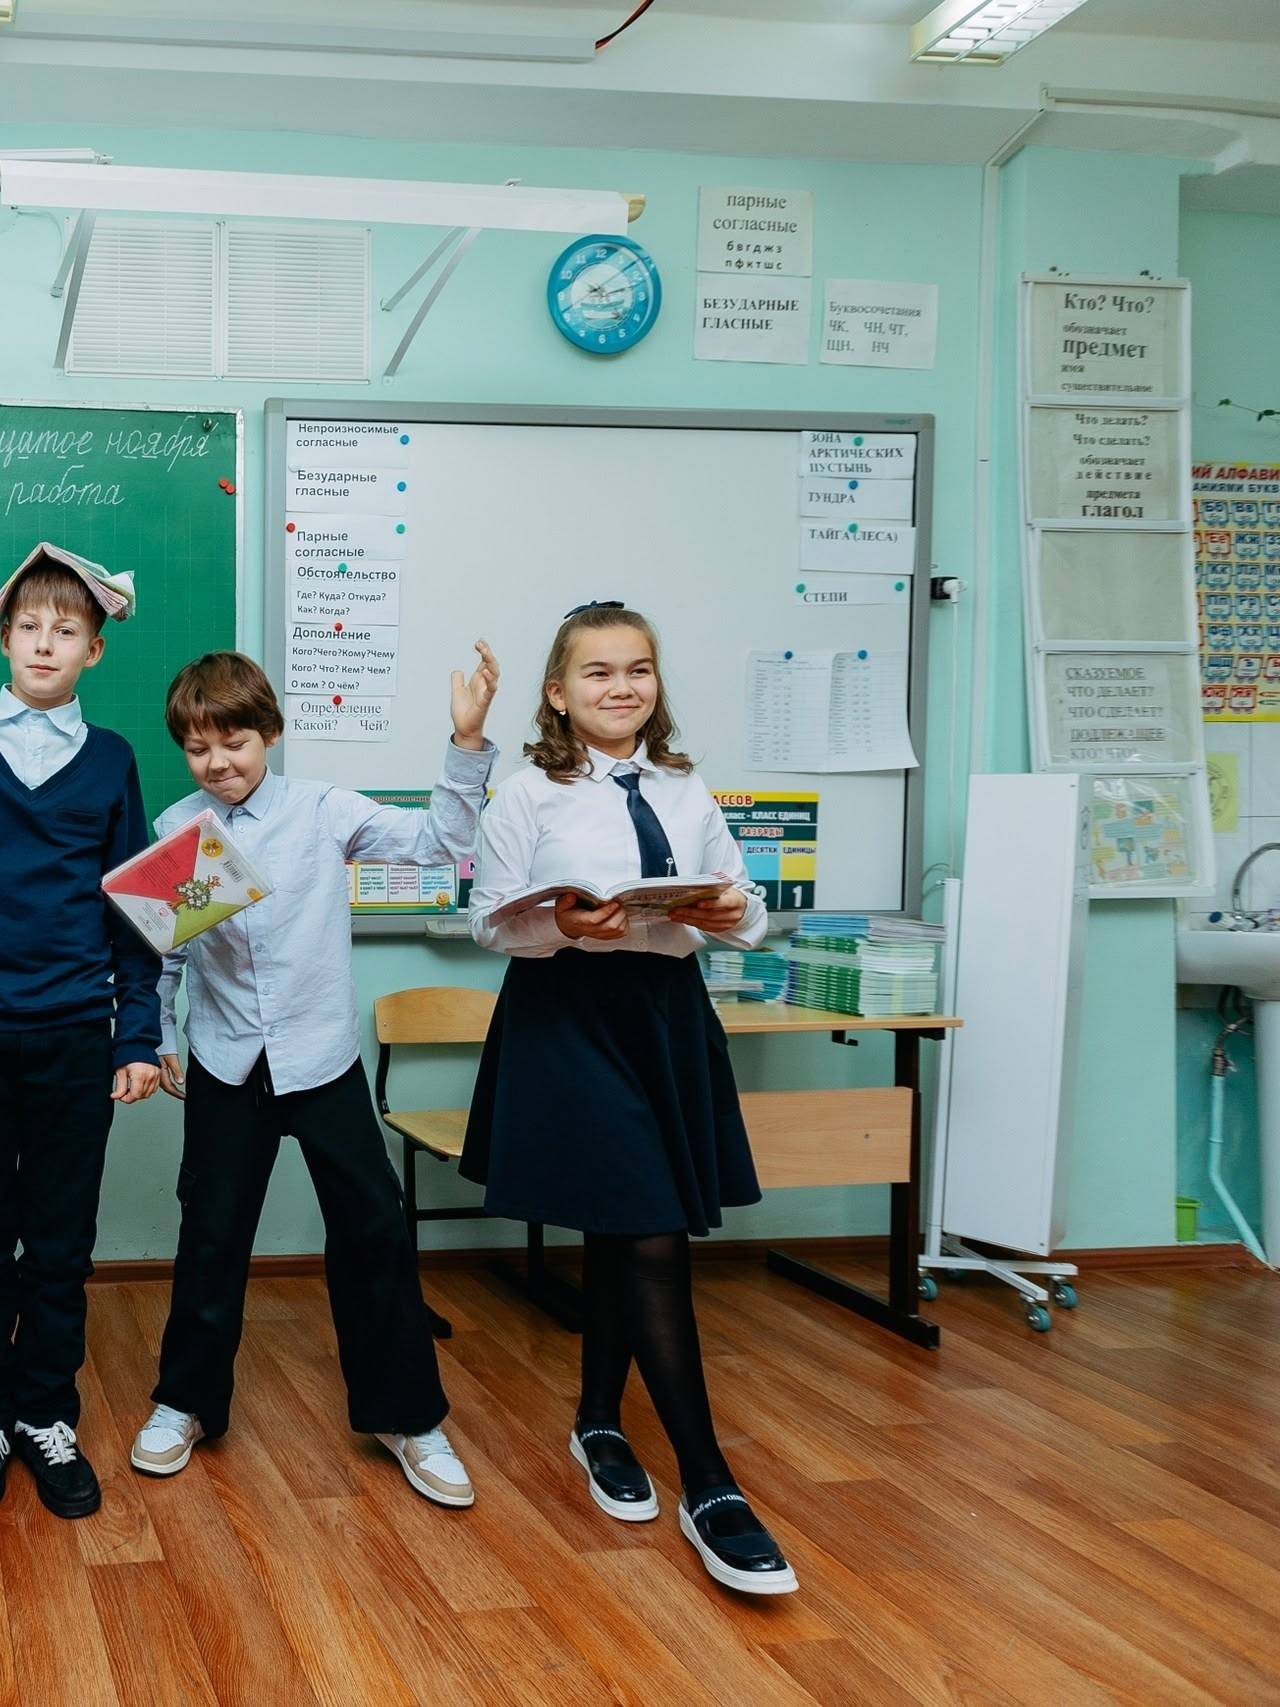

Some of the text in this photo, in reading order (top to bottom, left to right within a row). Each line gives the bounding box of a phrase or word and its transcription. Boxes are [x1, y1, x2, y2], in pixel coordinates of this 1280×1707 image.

[726, 194, 787, 211] парные
[713, 217, 798, 233] согласные
[596, 249, 607, 258] 12
[703, 298, 799, 312] БЕЗУДАРНЫЕ
[829, 301, 922, 317] Буквосочетания
[1064, 293, 1155, 313] Кто? Что?
[702, 317, 774, 331] ГЛАСНЫЕ
[1063, 340, 1149, 359] предмет
[1075, 414, 1098, 424] Что
[298, 423, 399, 435] Непроизносимые
[105, 414, 211, 473] ноября
[296, 438, 358, 447] согласные
[810, 433, 842, 443] ЗОНА
[1073, 434, 1096, 444] Что
[808, 448, 904, 458] АРКТИЧЕСКИХ
[810, 463, 872, 473] ПУСТЫНЬ
[1216, 467, 1280, 480] АЛФАВИ
[297, 470, 377, 484] Безударные
[5, 464, 125, 517] работа
[295, 487, 350, 497] гласные
[808, 492, 856, 504] ТУНДРА
[1082, 505, 1143, 518] глагол
[297, 531, 348, 543] Парные
[809, 528, 898, 543] ТАЙГА (ЛЕСА)
[295, 548, 365, 557] согласные
[297, 566, 396, 580] Обстоятельство
[297, 590, 386, 602] Где? Куда? Откуда?
[803, 592, 848, 602] СТЕПИ
[297, 605, 350, 616] Как? Когда?
[293, 627, 371, 640] Дополнение
[291, 664, 391, 675] Кого? Что? Кем? Чем?
[1065, 667, 1144, 679] СКАЗУЕМОЕ
[337, 681, 360, 690] чём?
[1067, 686, 1095, 697] ЧТО
[301, 701, 382, 716] Определение
[294, 719, 389, 731] Какой? Чей?
[740, 828, 784, 837] РАЗРЯДЫ
[783, 847, 816, 855] ЕДИНИЦЫ
[793, 885, 803, 908] 1
